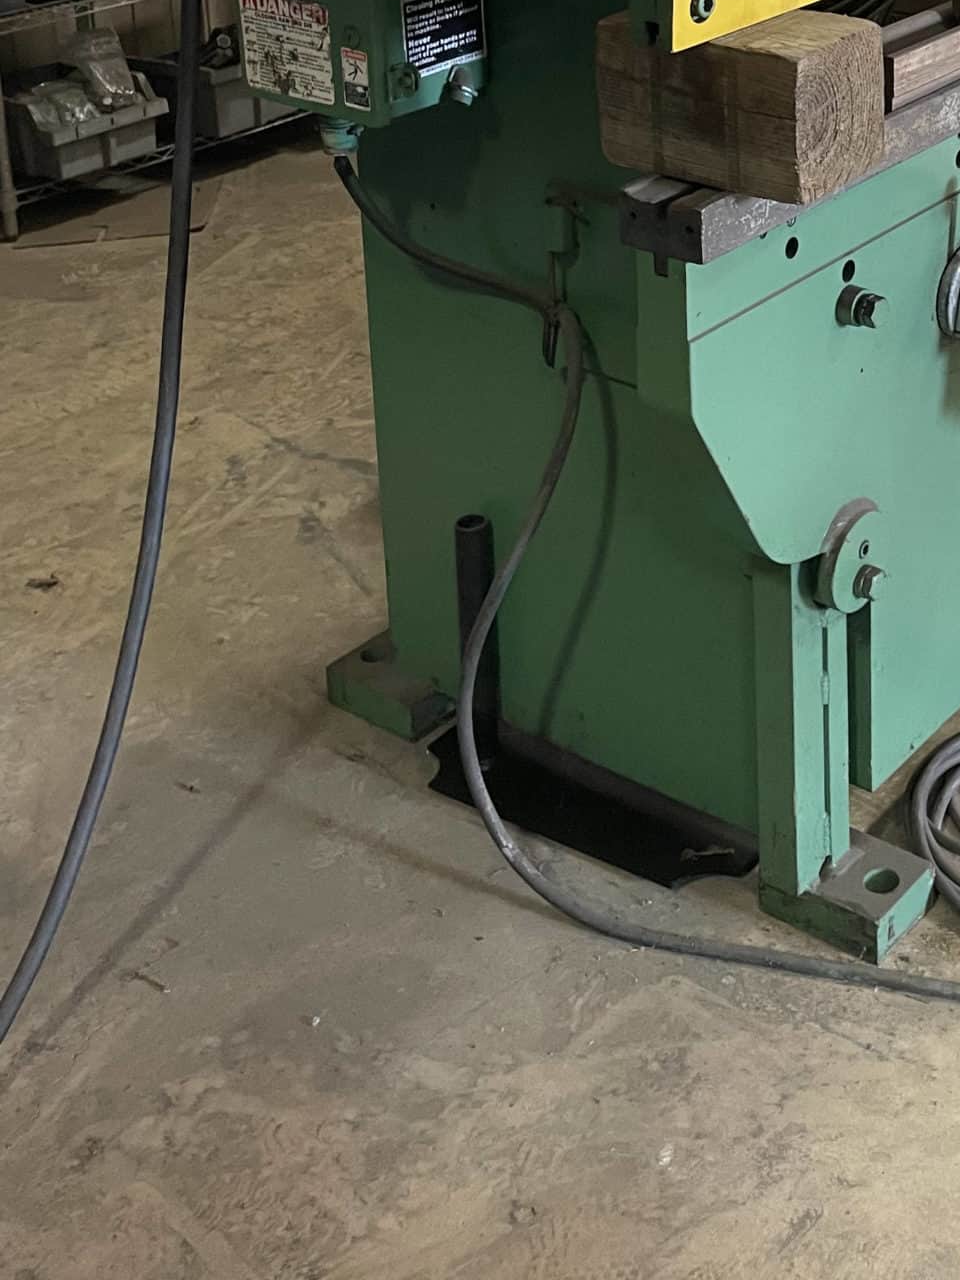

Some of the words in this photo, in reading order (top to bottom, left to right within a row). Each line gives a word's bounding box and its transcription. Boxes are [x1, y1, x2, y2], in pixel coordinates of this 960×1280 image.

[407, 1, 433, 14] Closing
[419, 10, 436, 20] result
[408, 36, 431, 48] Never
[409, 46, 425, 56] place
[426, 41, 440, 56] your
[440, 35, 458, 45] hands
[409, 53, 422, 63] part
[444, 42, 458, 51] body
